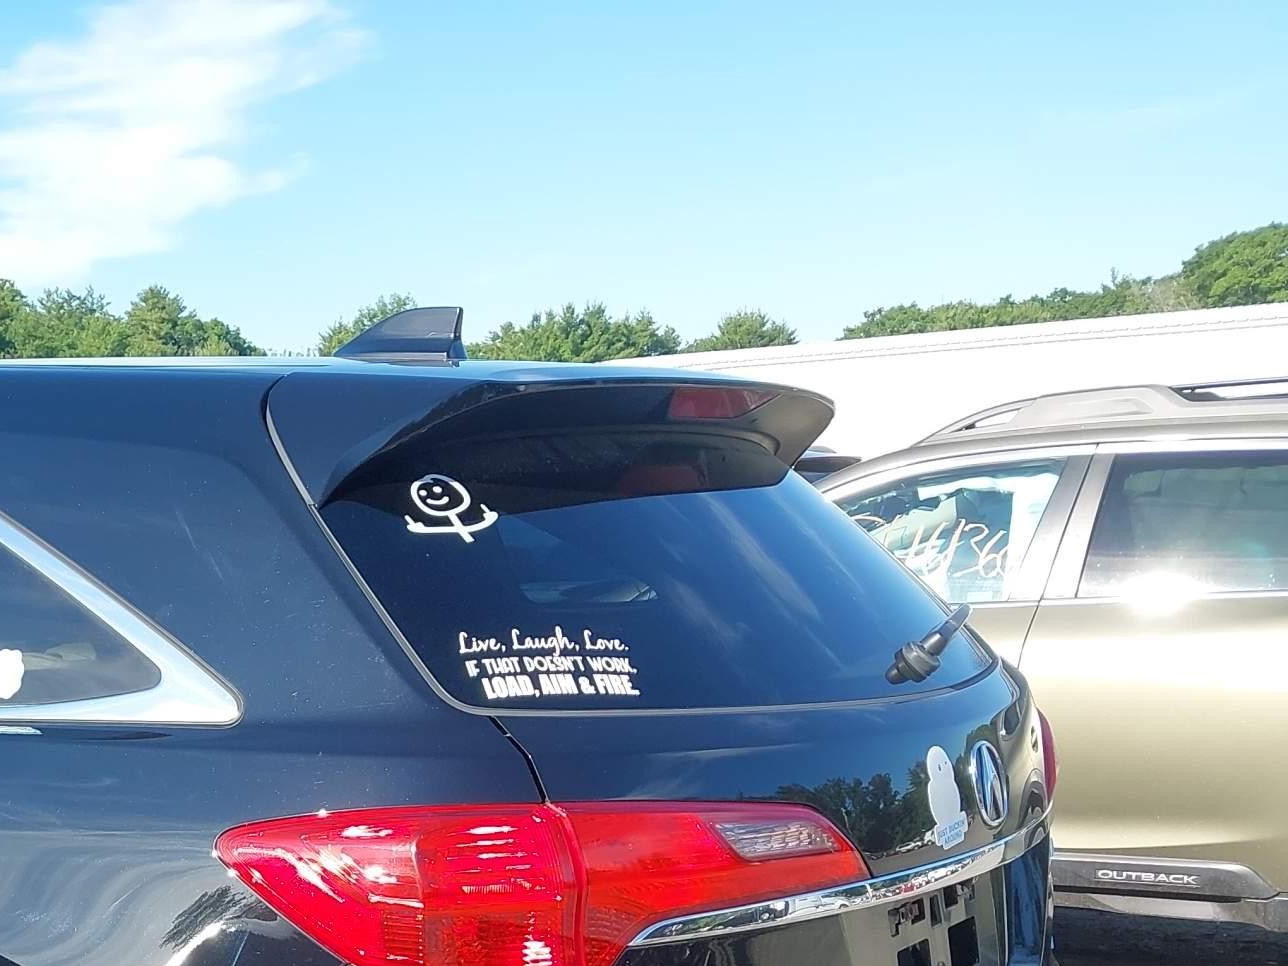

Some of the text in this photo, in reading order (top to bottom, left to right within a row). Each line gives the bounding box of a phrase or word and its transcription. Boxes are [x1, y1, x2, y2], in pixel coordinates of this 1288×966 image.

[458, 625, 629, 657] Live, Laugh, Love.
[465, 659, 481, 677] IF
[482, 656, 521, 675] THAT
[522, 655, 585, 672] DOESN'T
[481, 673, 641, 700] LOAD, AIM & FIRE.
[1097, 869, 1200, 885] OUTBACK
